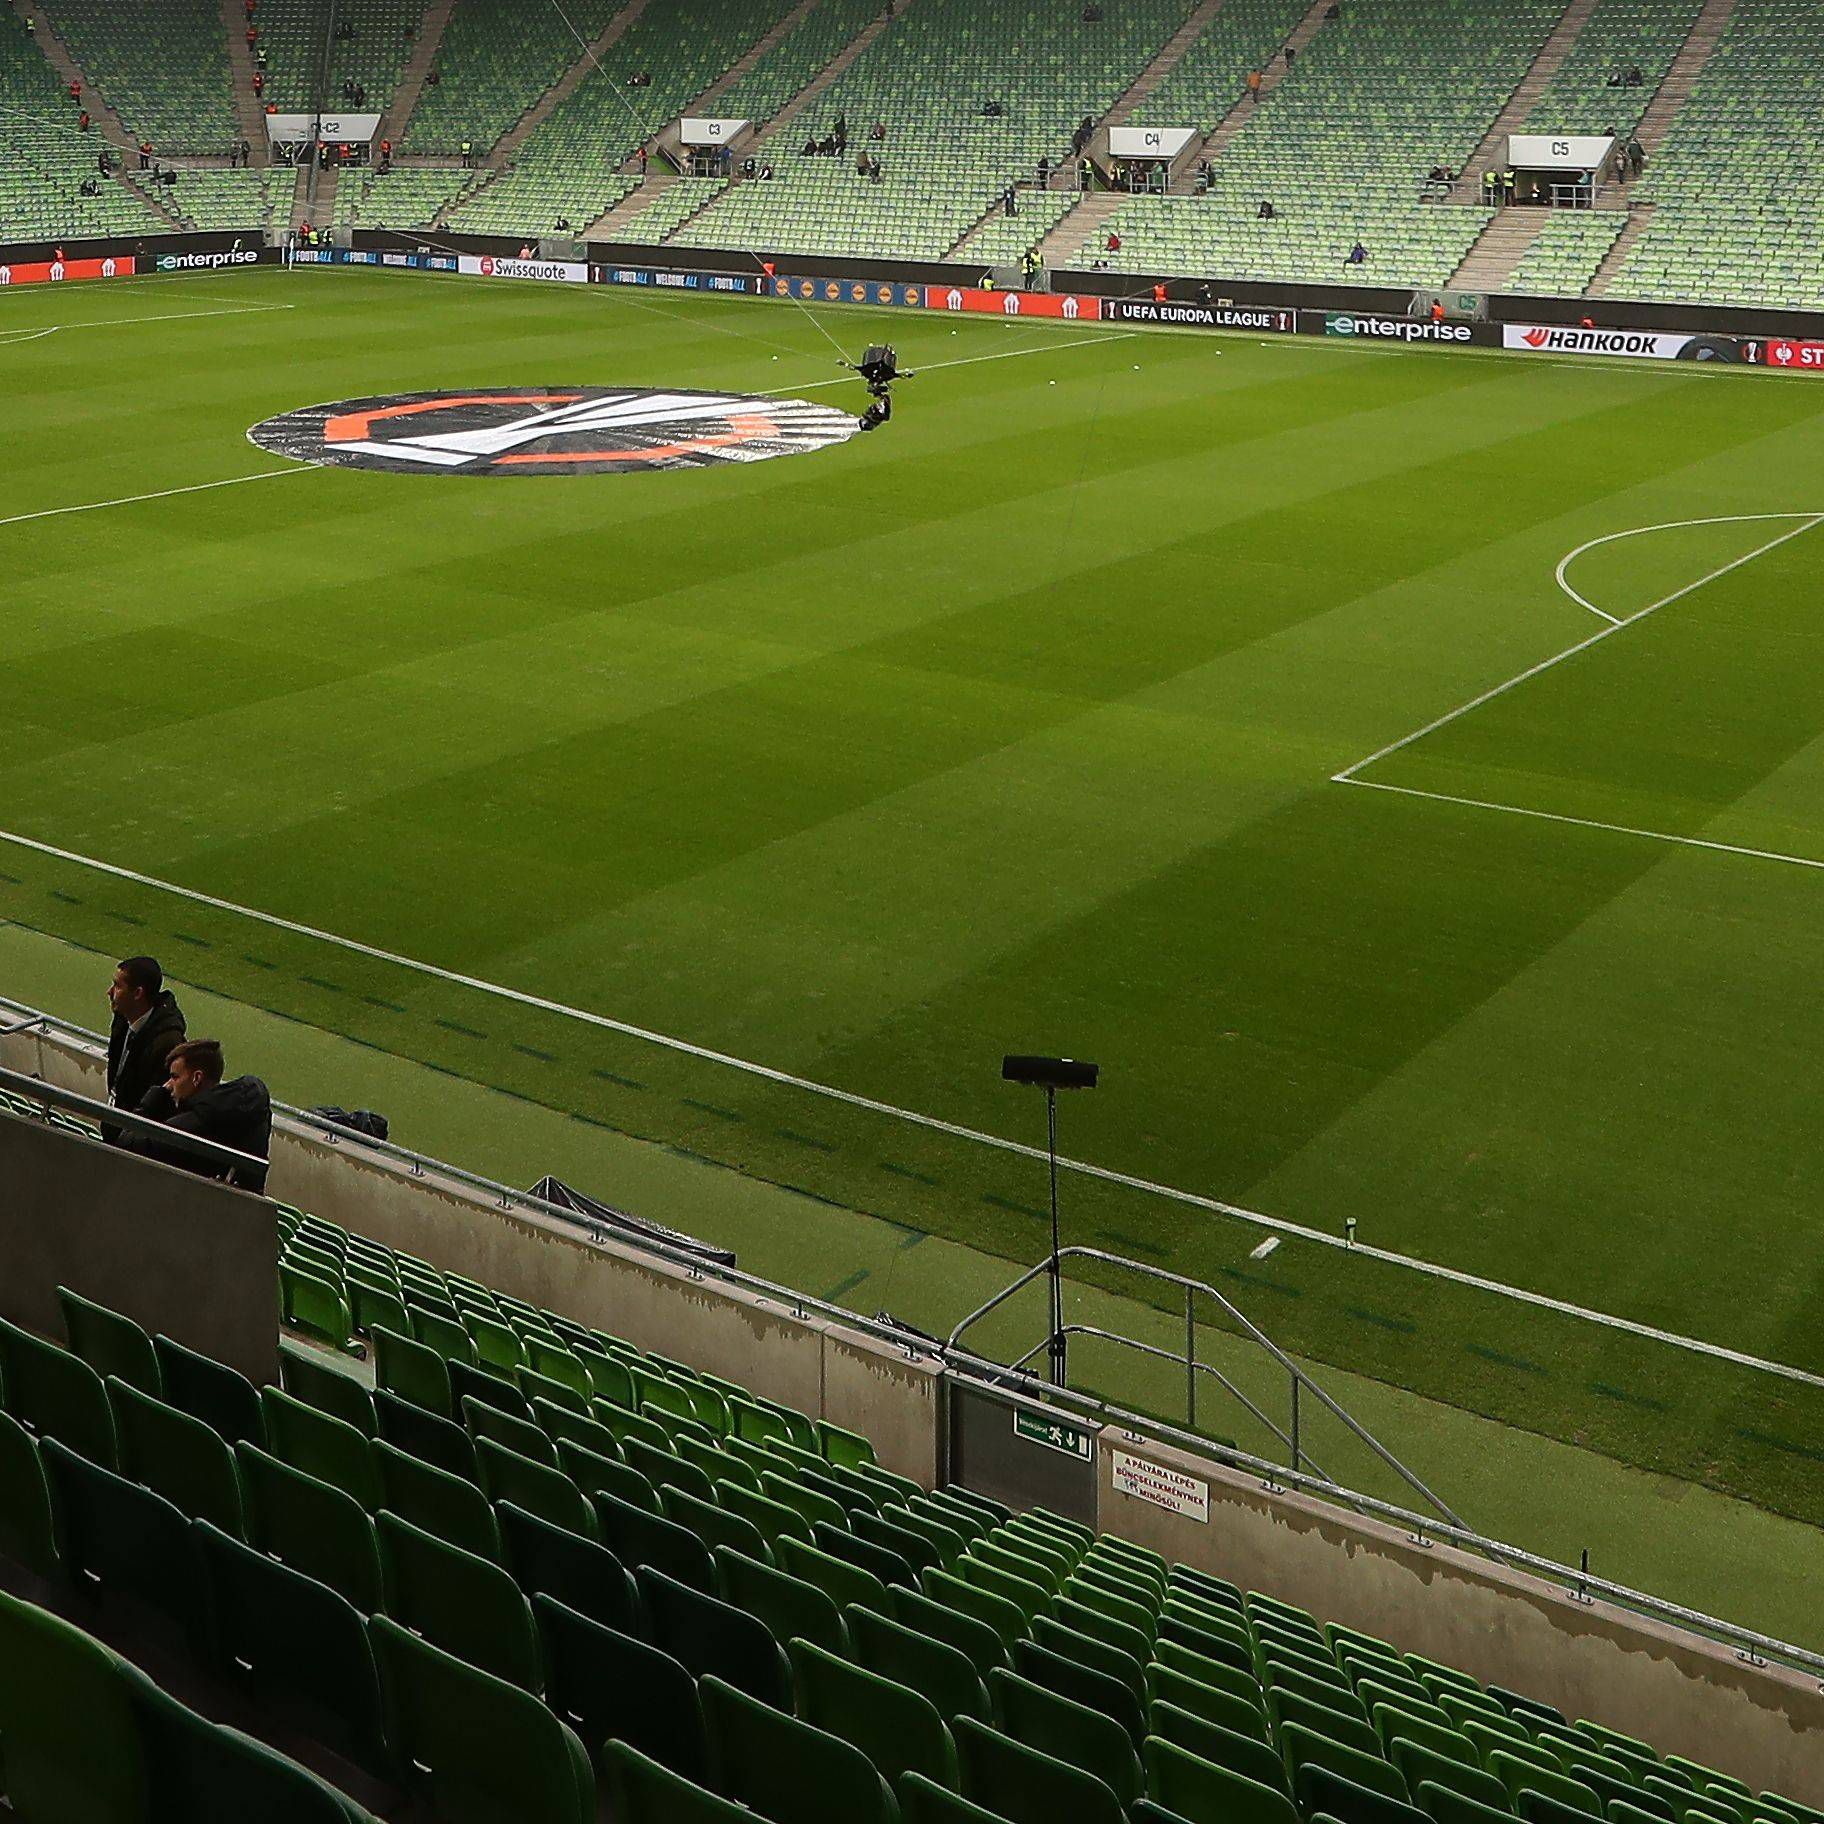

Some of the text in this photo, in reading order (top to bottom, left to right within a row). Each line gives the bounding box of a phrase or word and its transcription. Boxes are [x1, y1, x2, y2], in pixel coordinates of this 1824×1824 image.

[708, 123, 721, 135] C3
[1144, 133, 1160, 146] C4
[1551, 142, 1569, 155] C5
[157, 248, 257, 269] enterprise
[495, 259, 566, 279] Swissquote
[1122, 305, 1270, 327] UEFA EUROPA LEAGUE
[1325, 317, 1472, 341] enterprise
[1131, 1458, 1170, 1480] PÁLYÁRA
[1168, 1474, 1197, 1491] LÉPÉS
